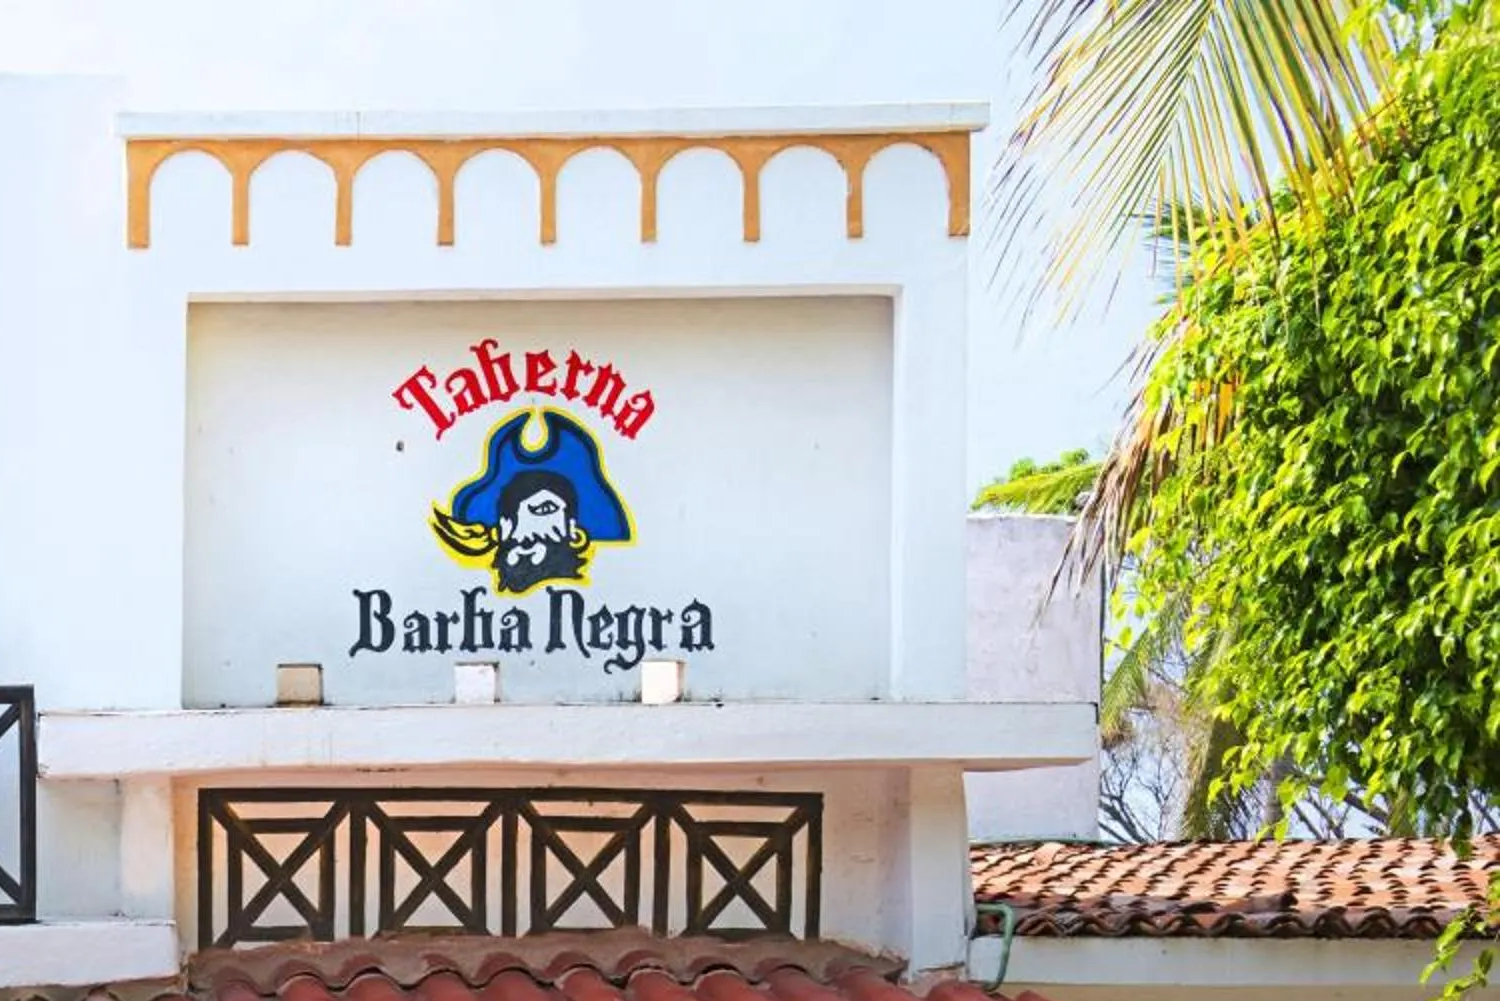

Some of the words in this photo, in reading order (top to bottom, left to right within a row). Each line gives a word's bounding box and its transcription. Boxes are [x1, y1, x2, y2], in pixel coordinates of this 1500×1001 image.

[392, 338, 655, 440] Taberna
[349, 586, 532, 657] Barba
[545, 586, 715, 674] Negra
